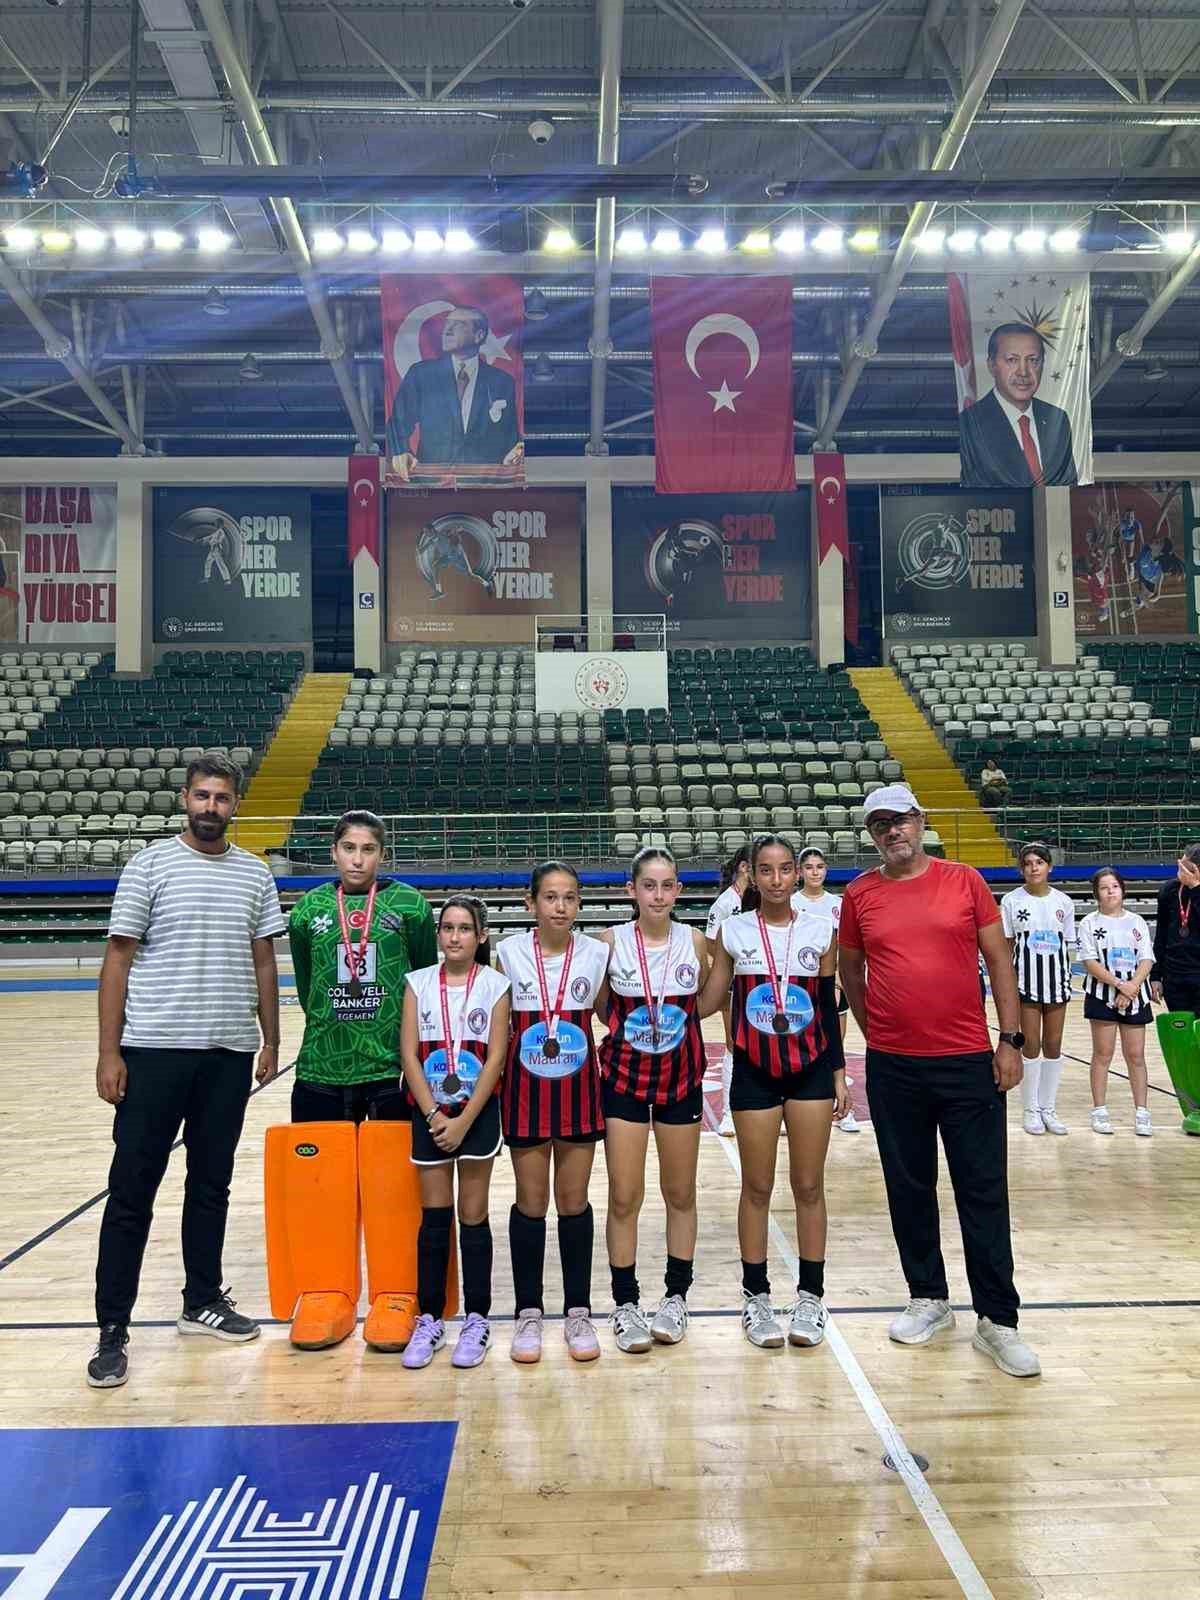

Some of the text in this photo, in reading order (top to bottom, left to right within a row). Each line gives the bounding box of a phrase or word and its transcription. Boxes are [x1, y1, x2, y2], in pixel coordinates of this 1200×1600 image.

[25, 486, 93, 528] BAŞA
[240, 516, 292, 541] SPOR
[492, 510, 547, 538] SPOR
[723, 514, 776, 540] SPOR
[966, 508, 1016, 533] SPOR
[241, 544, 276, 569] HER
[495, 541, 531, 568] HER
[970, 536, 1001, 561] HER
[241, 572, 301, 598] YERDE
[494, 572, 553, 599] YERDE
[723, 575, 784, 601] YERDE
[969, 564, 1024, 589] YERDE
[1055, 592, 1066, 603] D
[333, 997, 381, 1008] BANKER
[338, 1012, 375, 1020] EGEMEN
